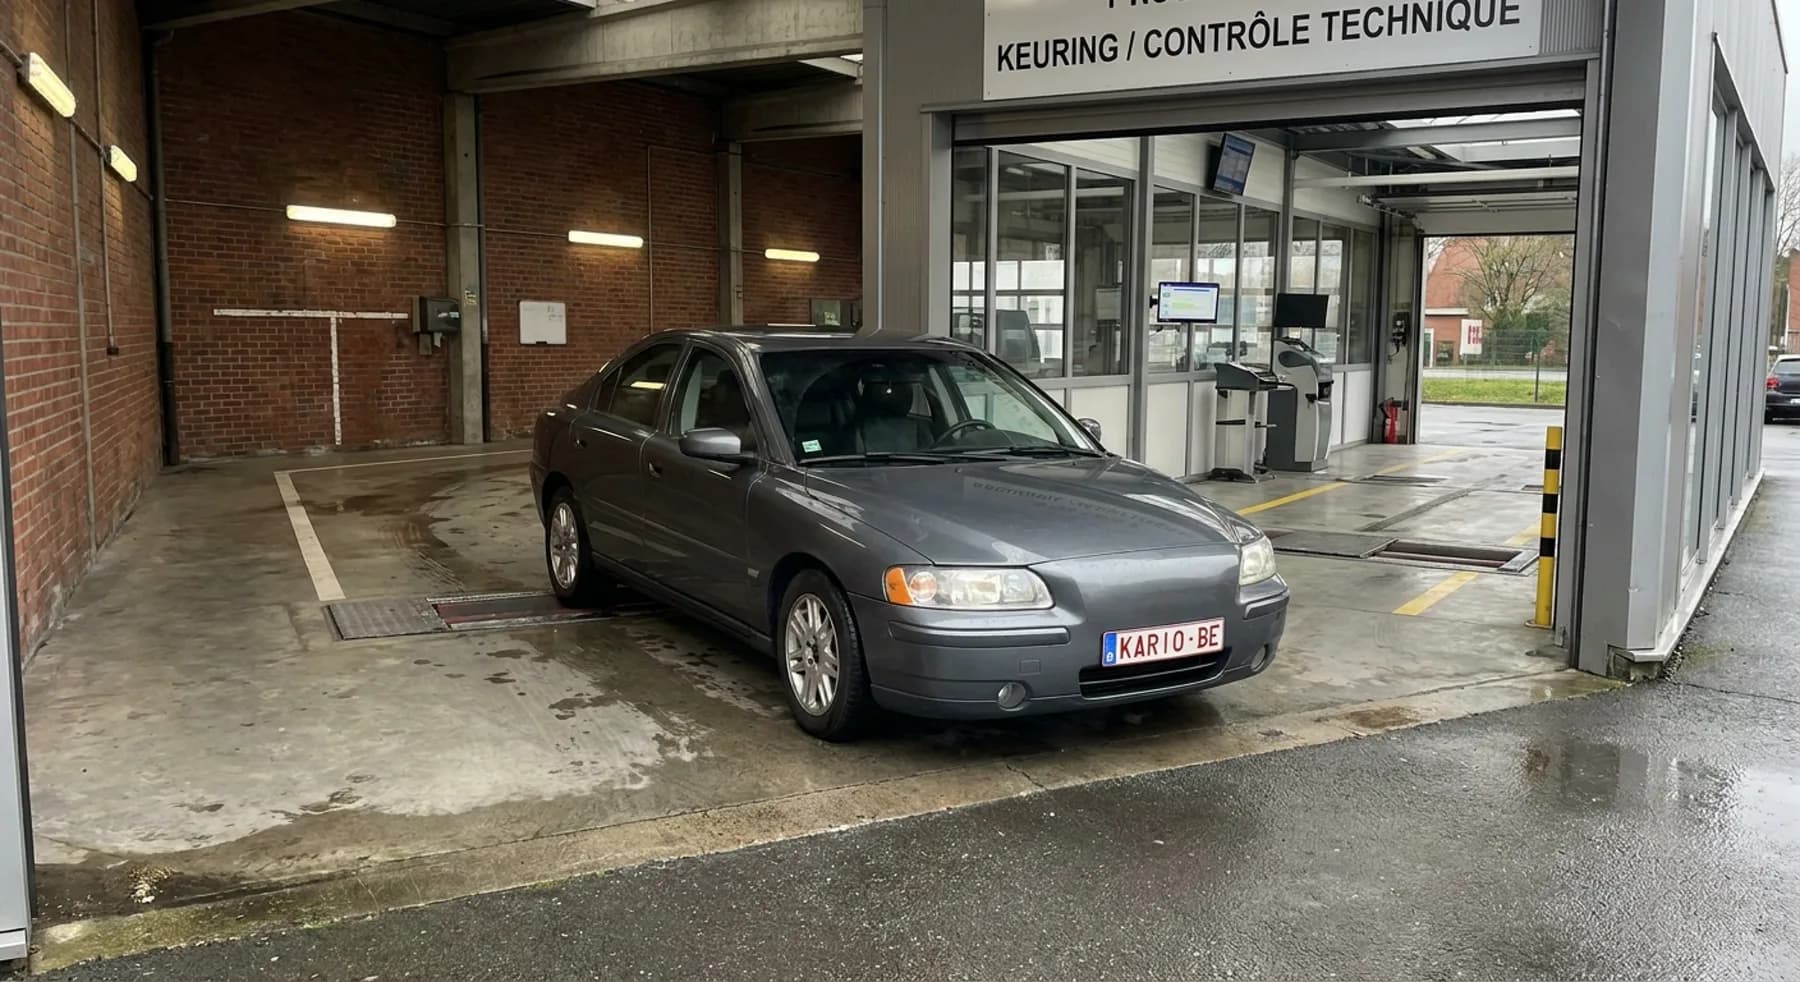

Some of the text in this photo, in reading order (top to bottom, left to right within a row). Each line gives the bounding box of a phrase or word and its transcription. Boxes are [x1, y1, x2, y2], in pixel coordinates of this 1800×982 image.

[997, 0, 1520, 72] KEURING / CONTRÔLE TECHNIQUE
